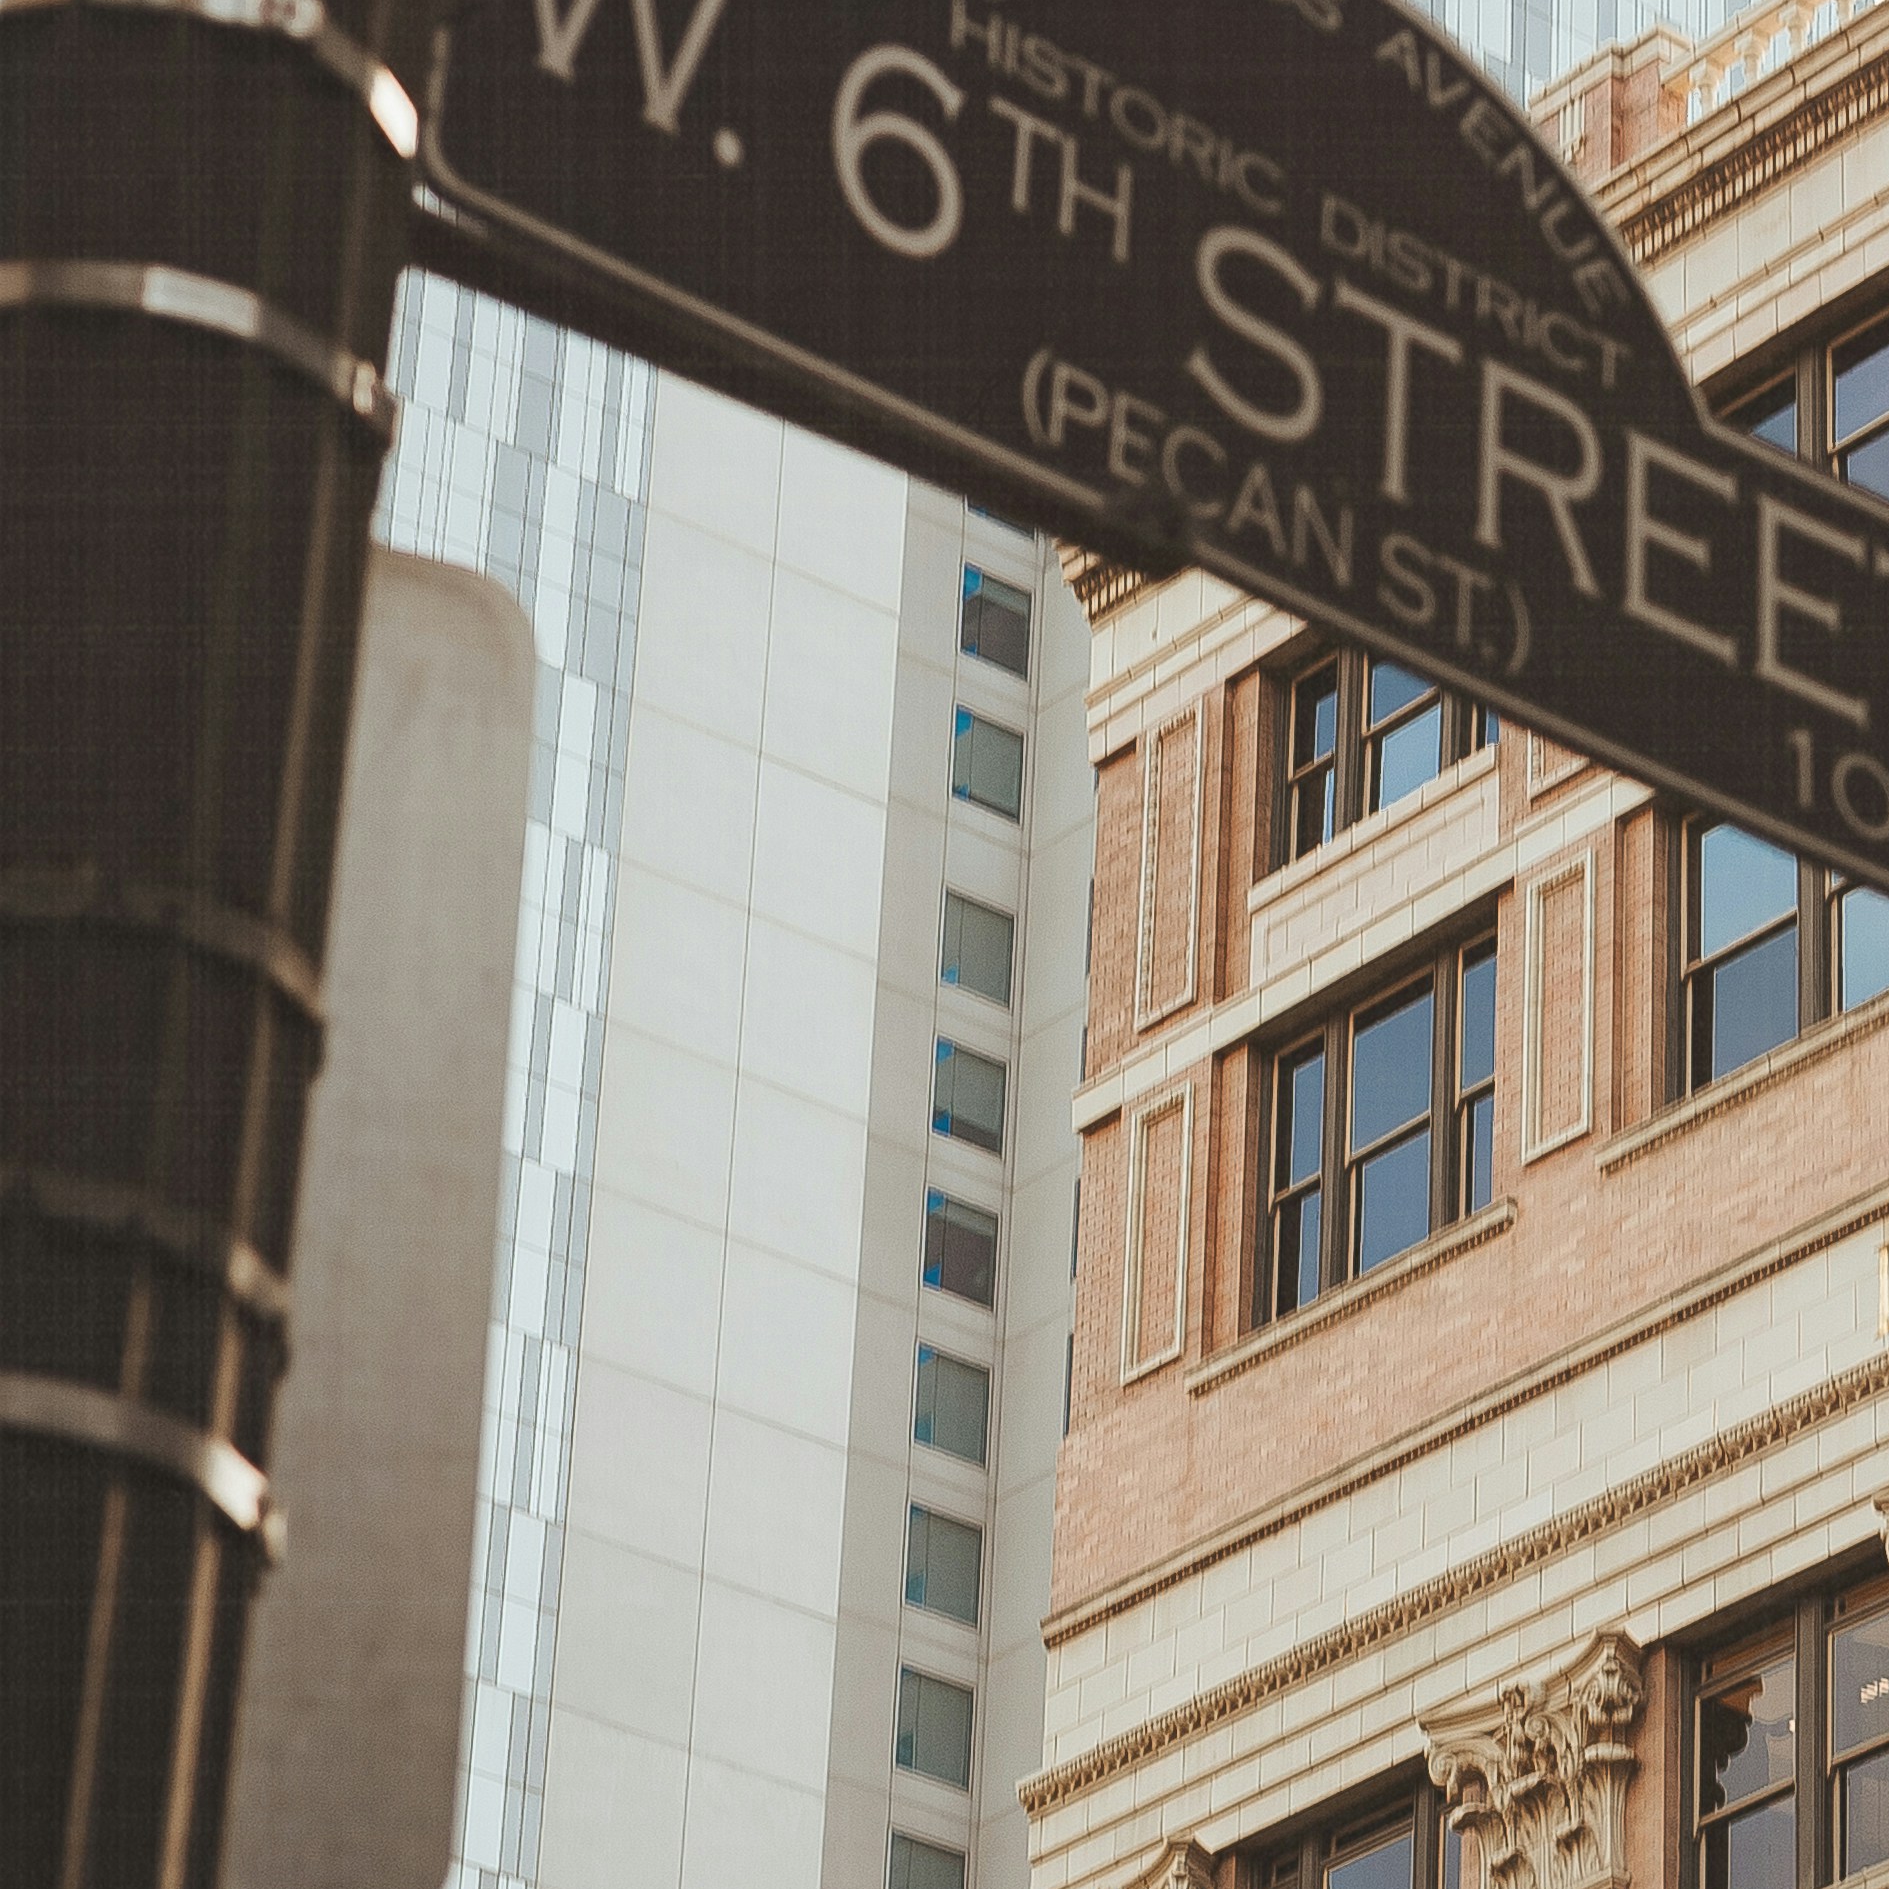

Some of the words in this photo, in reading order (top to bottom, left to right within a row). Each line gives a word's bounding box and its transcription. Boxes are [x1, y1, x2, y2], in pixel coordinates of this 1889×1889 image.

[831, 43, 1134, 264] 6TH
[1374, 27, 1634, 316] AVENUE
[1317, 191, 1633, 391] DISTRICT
[1021, 346, 1358, 589] (PECAN
[1376, 529, 1533, 678] ST.)
